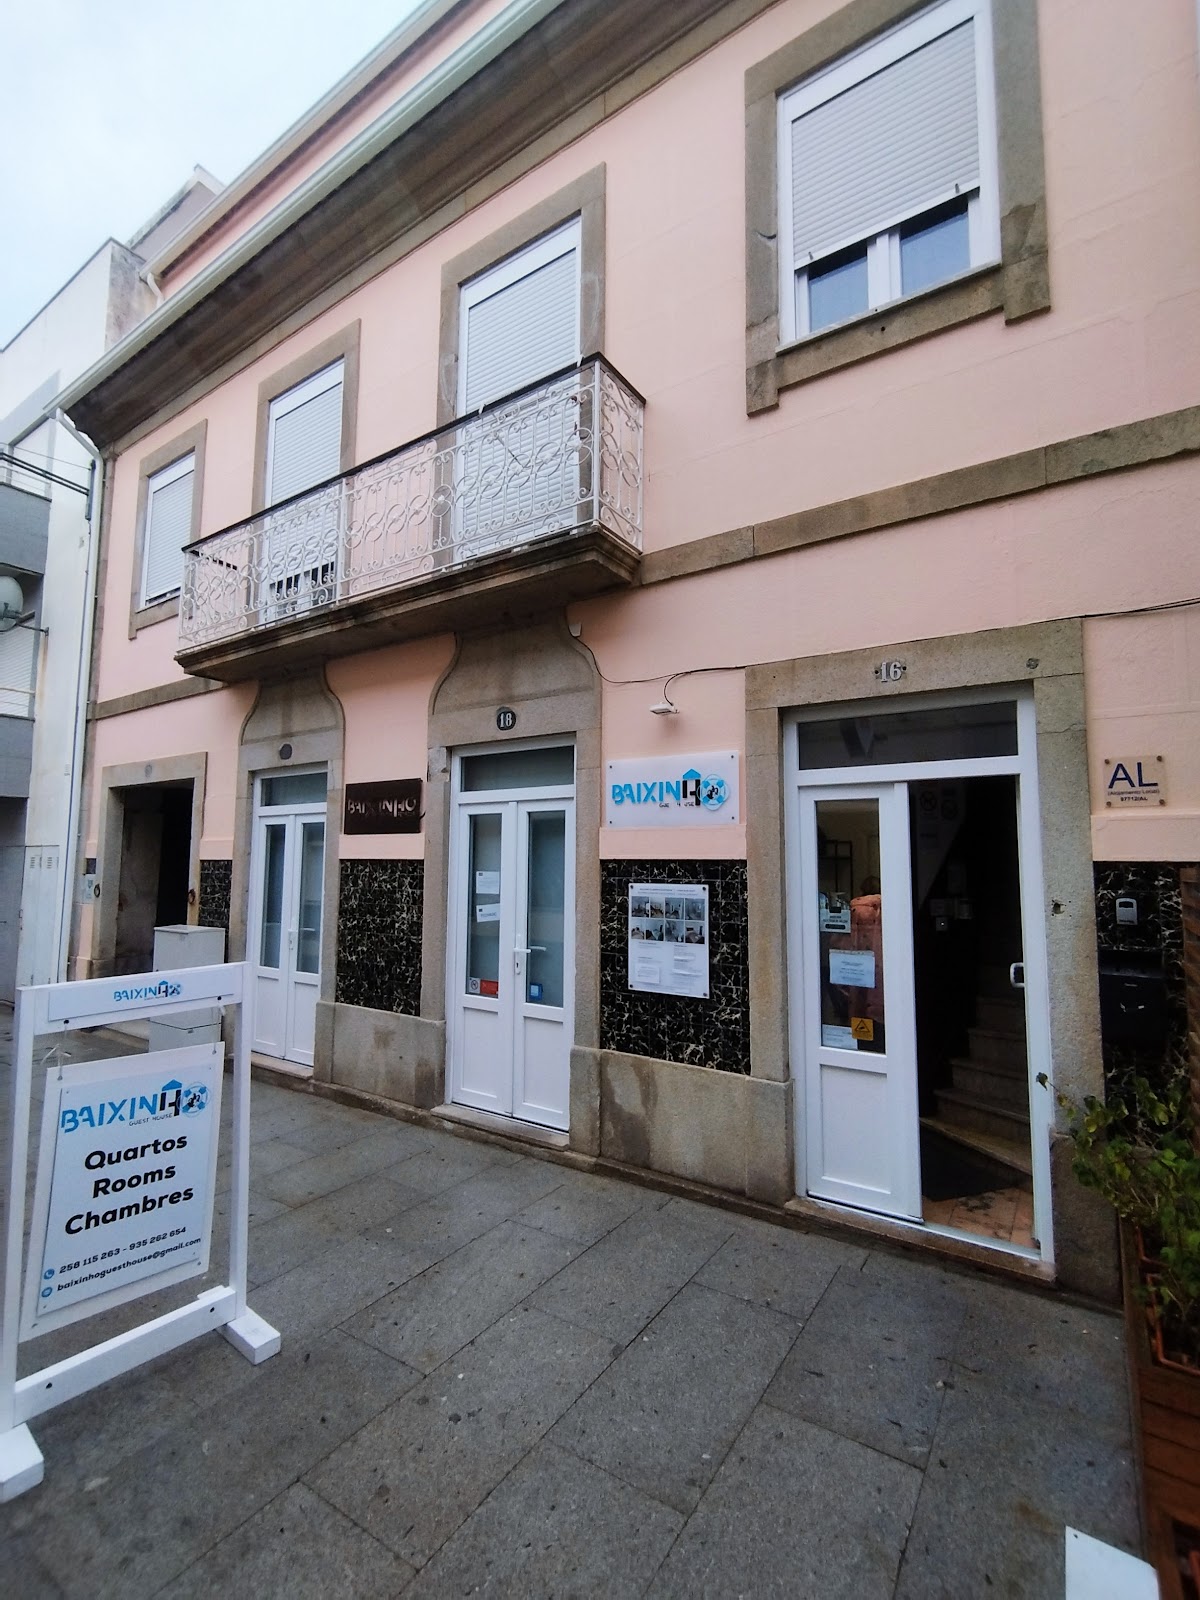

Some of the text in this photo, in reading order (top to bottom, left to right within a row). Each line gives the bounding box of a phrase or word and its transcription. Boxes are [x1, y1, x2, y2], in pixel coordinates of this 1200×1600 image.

[881, 661, 902, 682] 16
[500, 712, 512, 728] 18
[1108, 761, 1159, 789] AL
[129, 1112, 173, 1127] GUEST HOUSE
[84, 1135, 188, 1170] Quartos
[92, 1165, 176, 1199] Rooms
[64, 1187, 194, 1235] Chambres
[57, 1237, 202, 1292] baixinhoguesthouse@gmail.com
[58, 1261, 81, 1274] 258
[83, 1254, 99, 1267] 115
[101, 1247, 121, 1260] 263
[129, 1238, 148, 1251] 935
[150, 1232, 168, 1245] 262
[169, 1226, 187, 1238] 654
